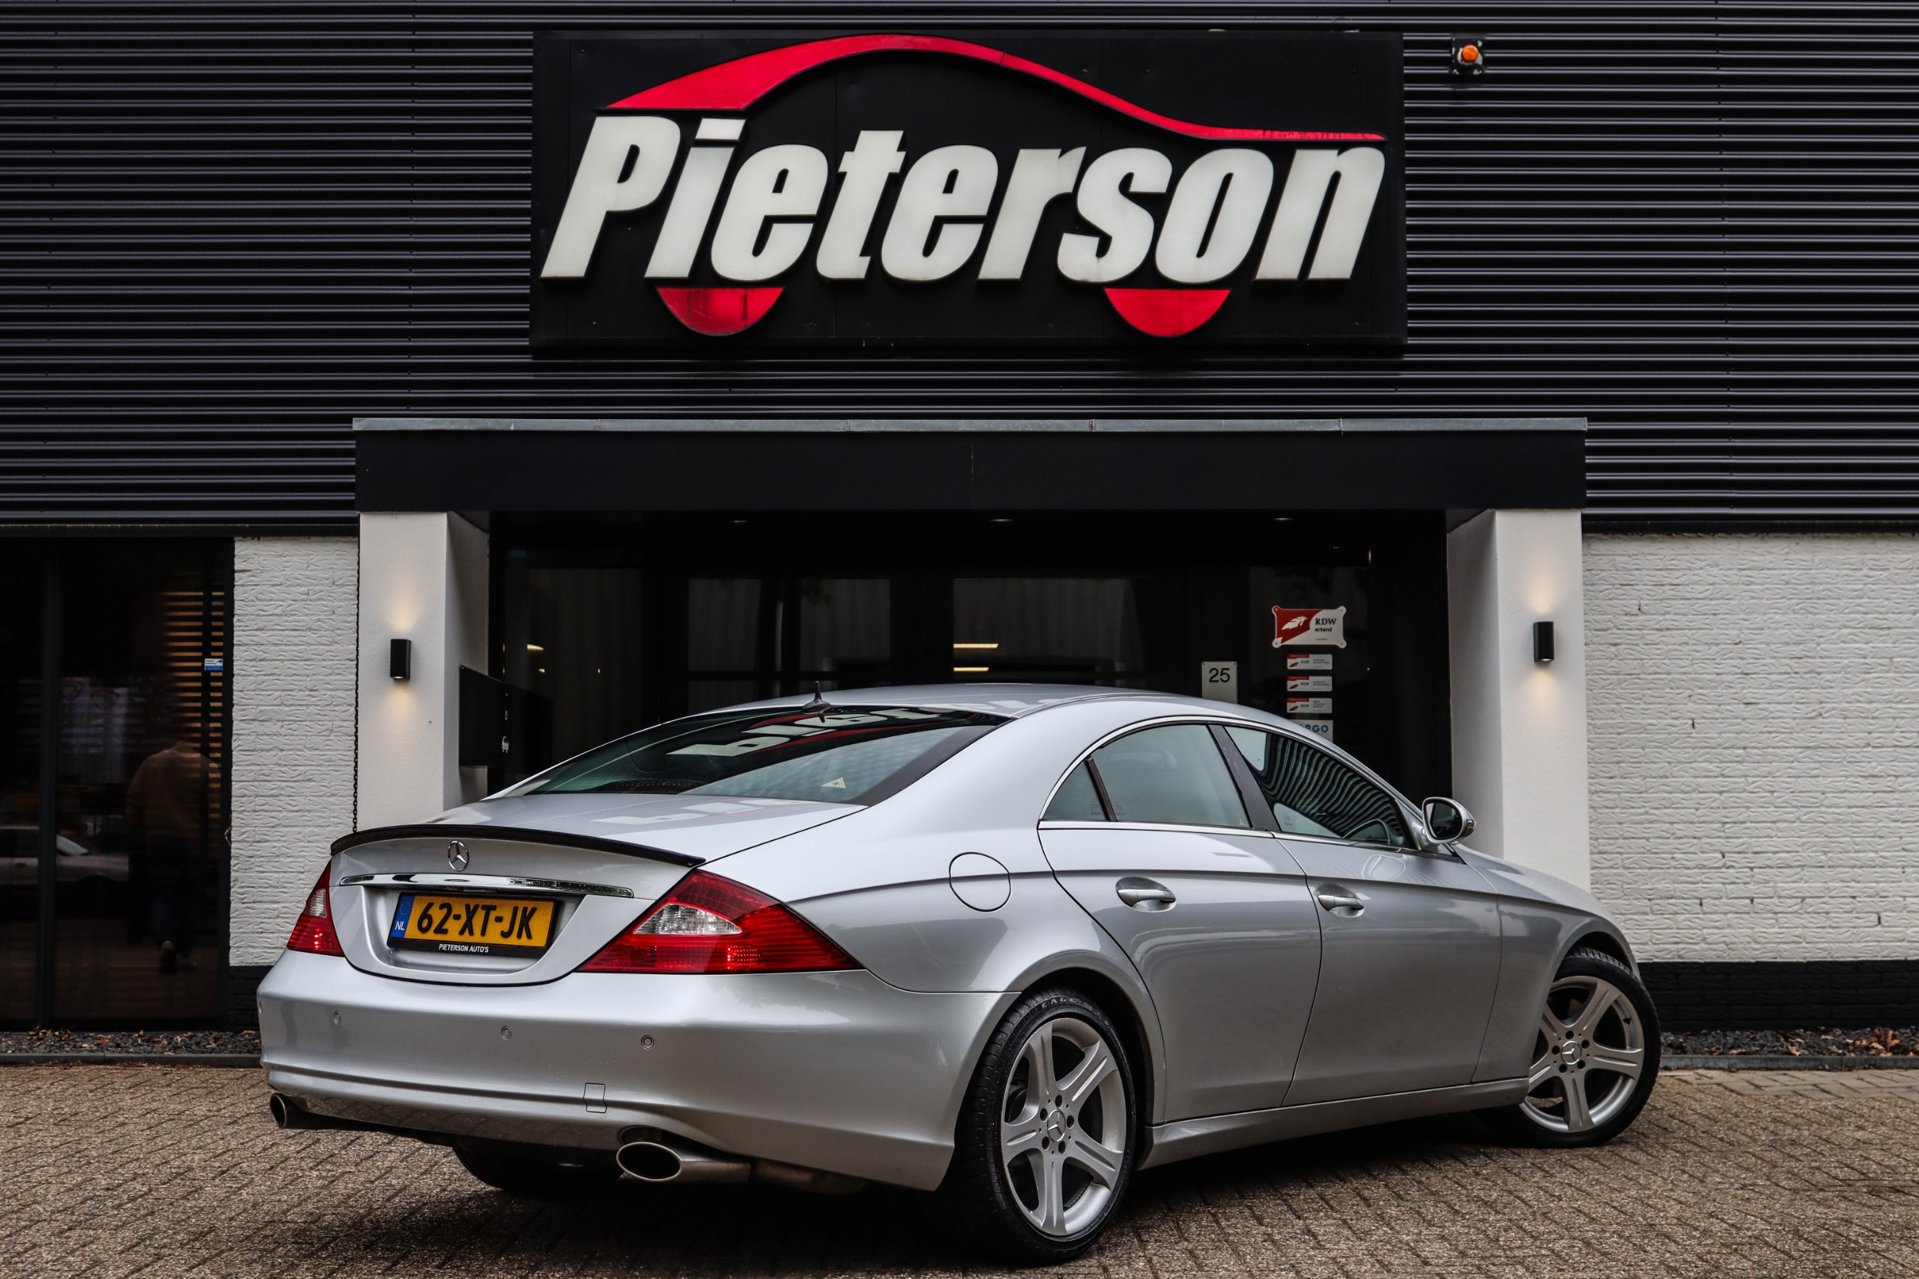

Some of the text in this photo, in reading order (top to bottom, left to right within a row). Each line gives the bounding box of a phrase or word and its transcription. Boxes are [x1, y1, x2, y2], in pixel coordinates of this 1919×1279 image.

[541, 116, 1386, 283] Pieterson
[1209, 668, 1230, 683] 25
[394, 921, 405, 931] NL
[417, 902, 537, 939] 62-XT-JK
[438, 943, 490, 954] PIETERSON AUTO'S
